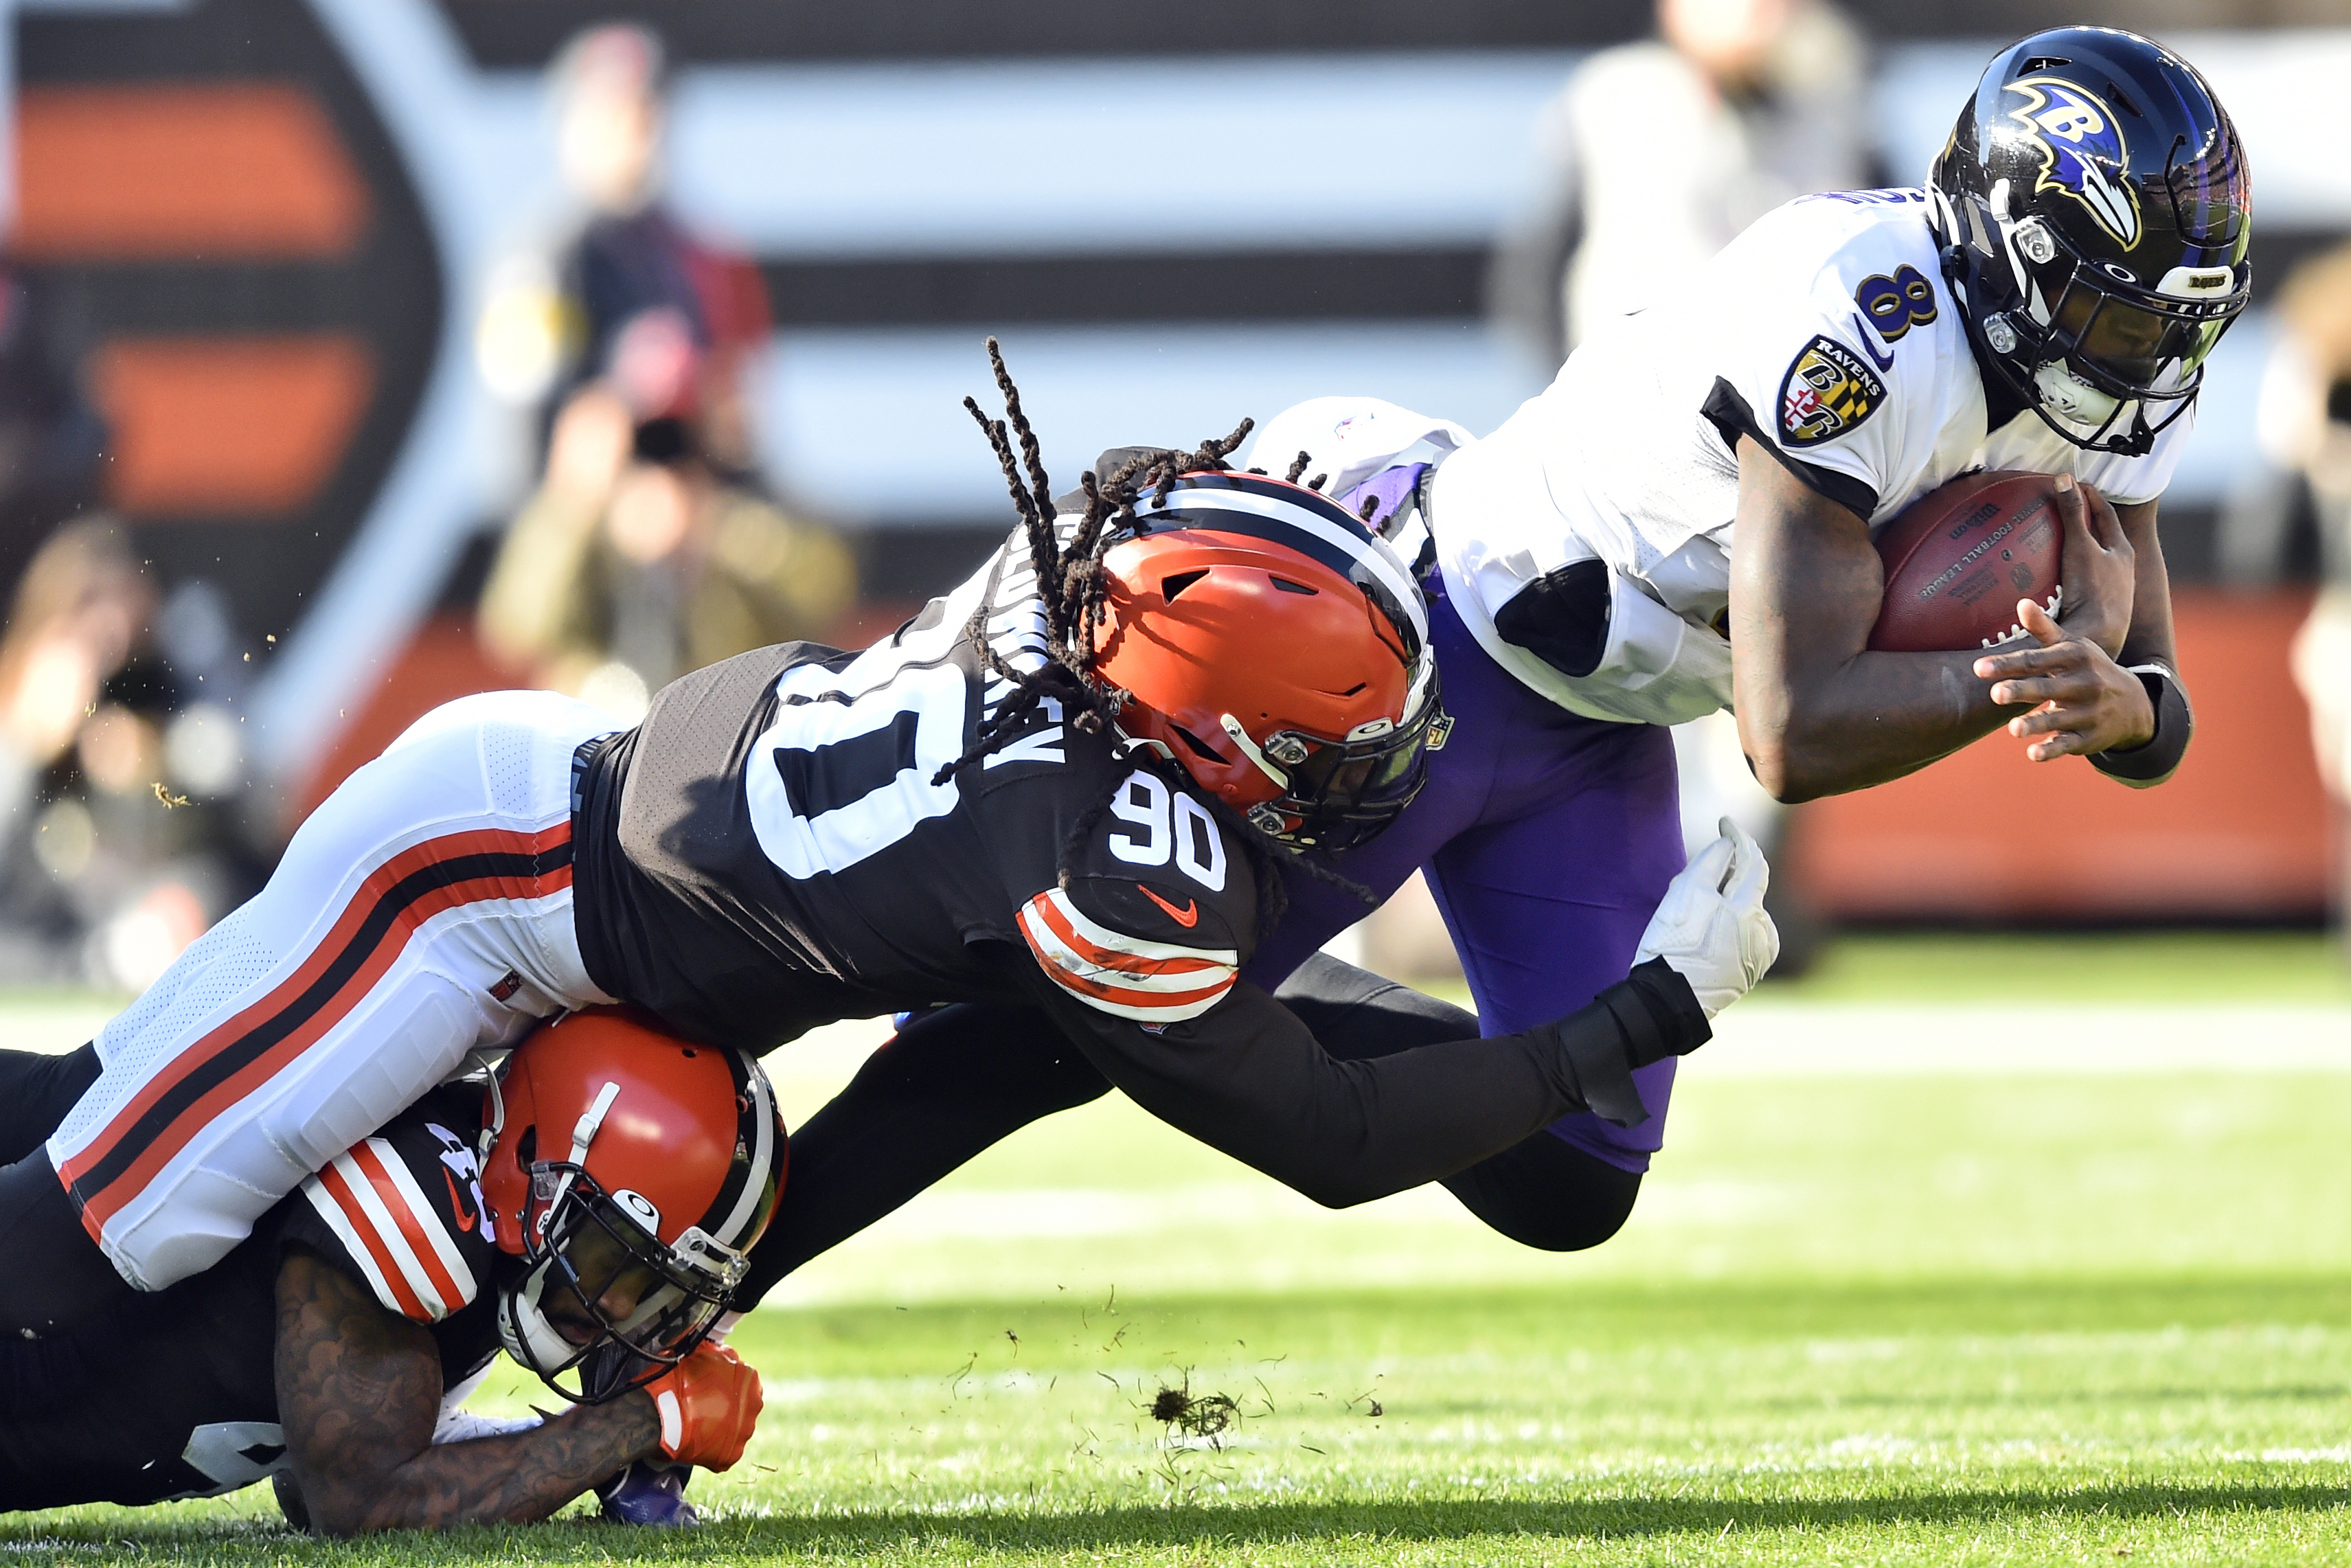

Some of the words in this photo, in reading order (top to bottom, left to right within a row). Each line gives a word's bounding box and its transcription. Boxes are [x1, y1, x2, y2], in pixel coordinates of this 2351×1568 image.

[1854, 263, 1938, 343] 8
[1816, 339, 1881, 396] RAVENS
[1962, 522, 2014, 565] FOOTBALL
[1918, 563, 1964, 602] LEAGUE
[1109, 769, 1227, 892] 90
